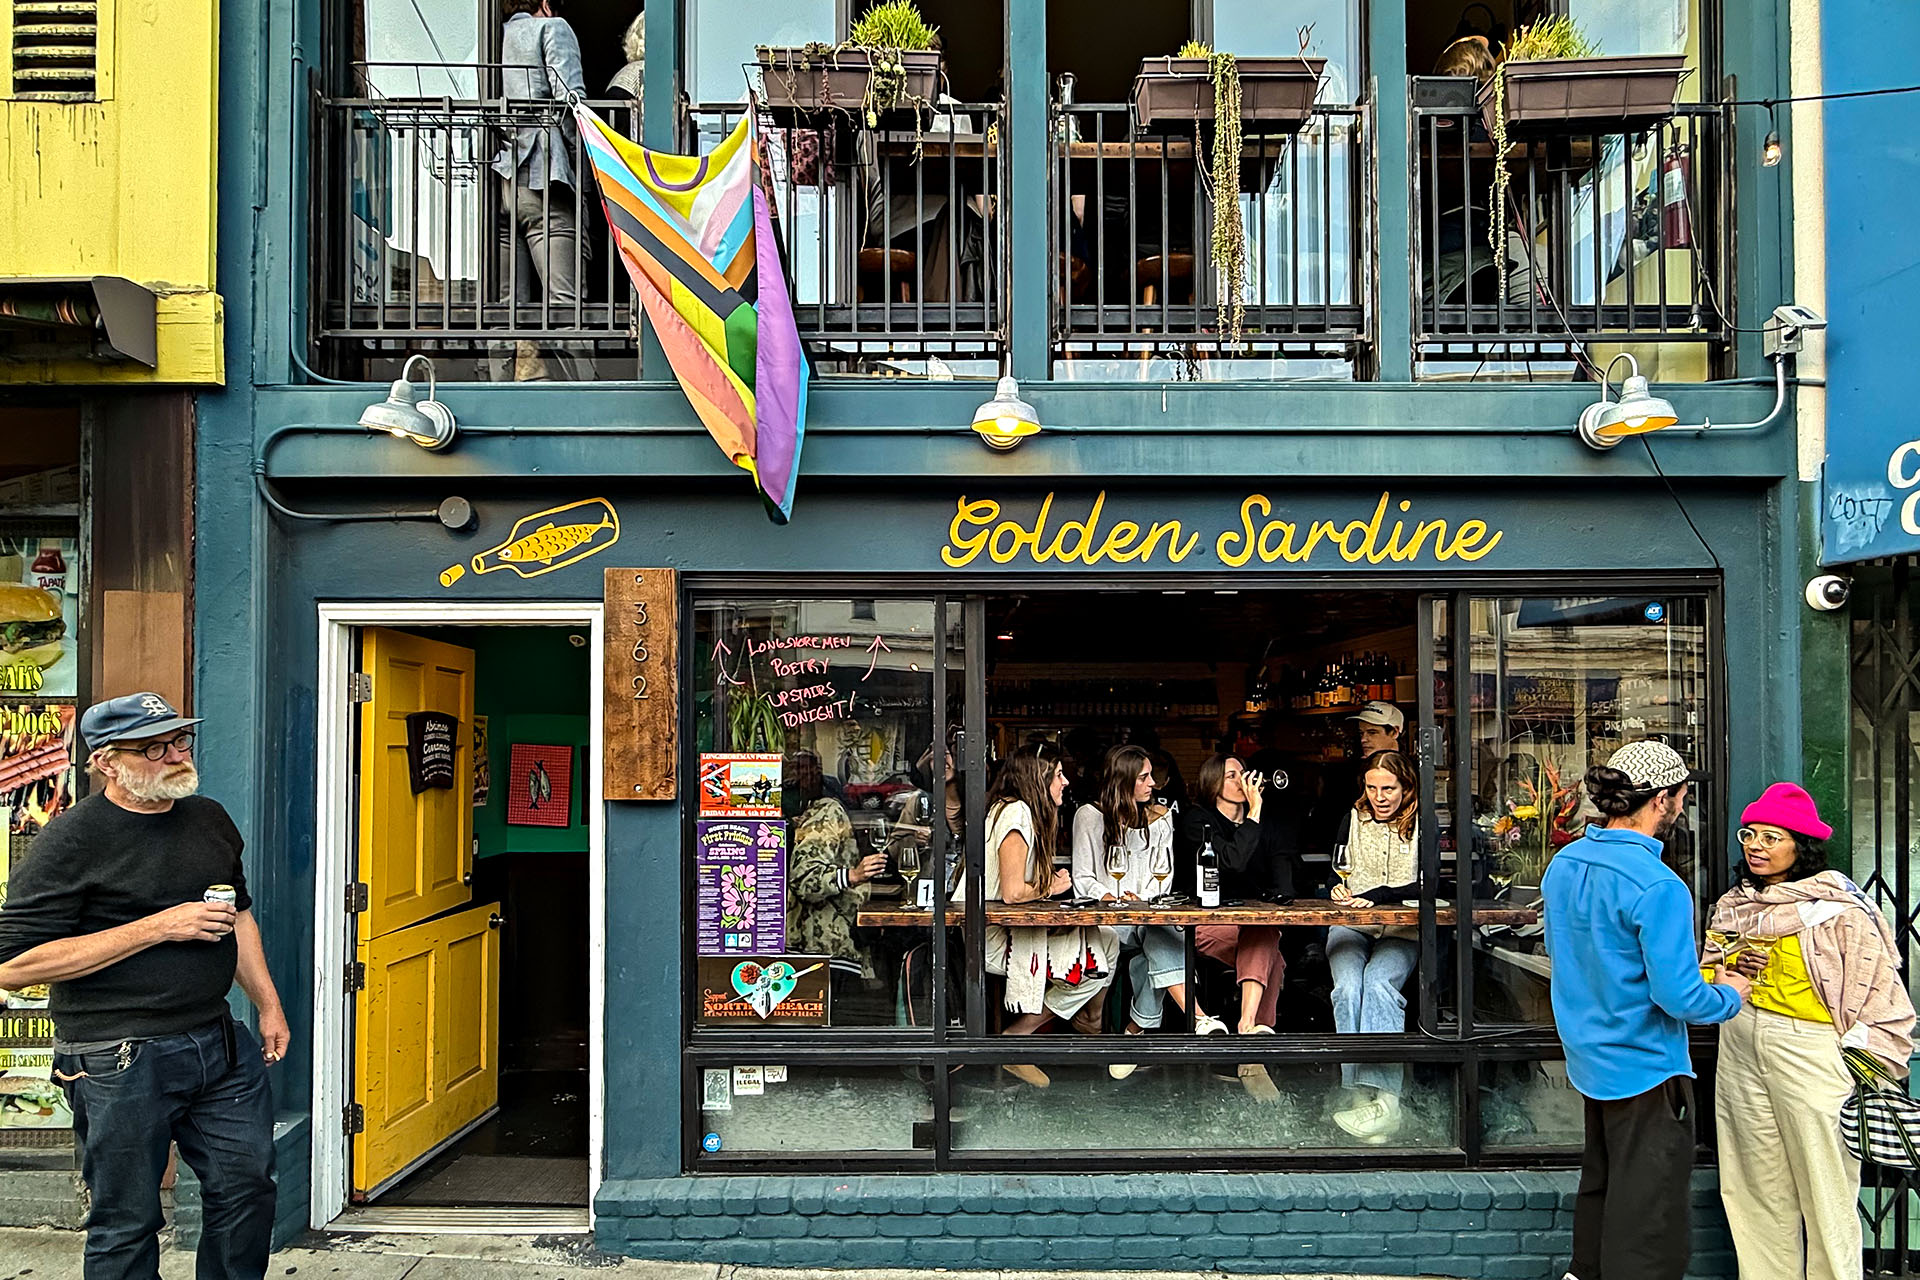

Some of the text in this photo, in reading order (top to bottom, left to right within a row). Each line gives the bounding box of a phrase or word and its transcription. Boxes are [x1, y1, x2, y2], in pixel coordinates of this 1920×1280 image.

[940, 490, 1504, 568] Golden Sardine
[1647, 606, 1660, 614] ADT
[747, 636, 850, 657] LONGSHOREMEN
[770, 657, 830, 678] POETRY
[768, 681, 836, 707] UPSTAIRS
[777, 690, 856, 728] TONIGHT!
[10, 712, 62, 735] DOGS
[923, 884, 930, 904] 1
[776, 1002, 823, 1011] BEACH
[705, 1138, 720, 1146] ADT
